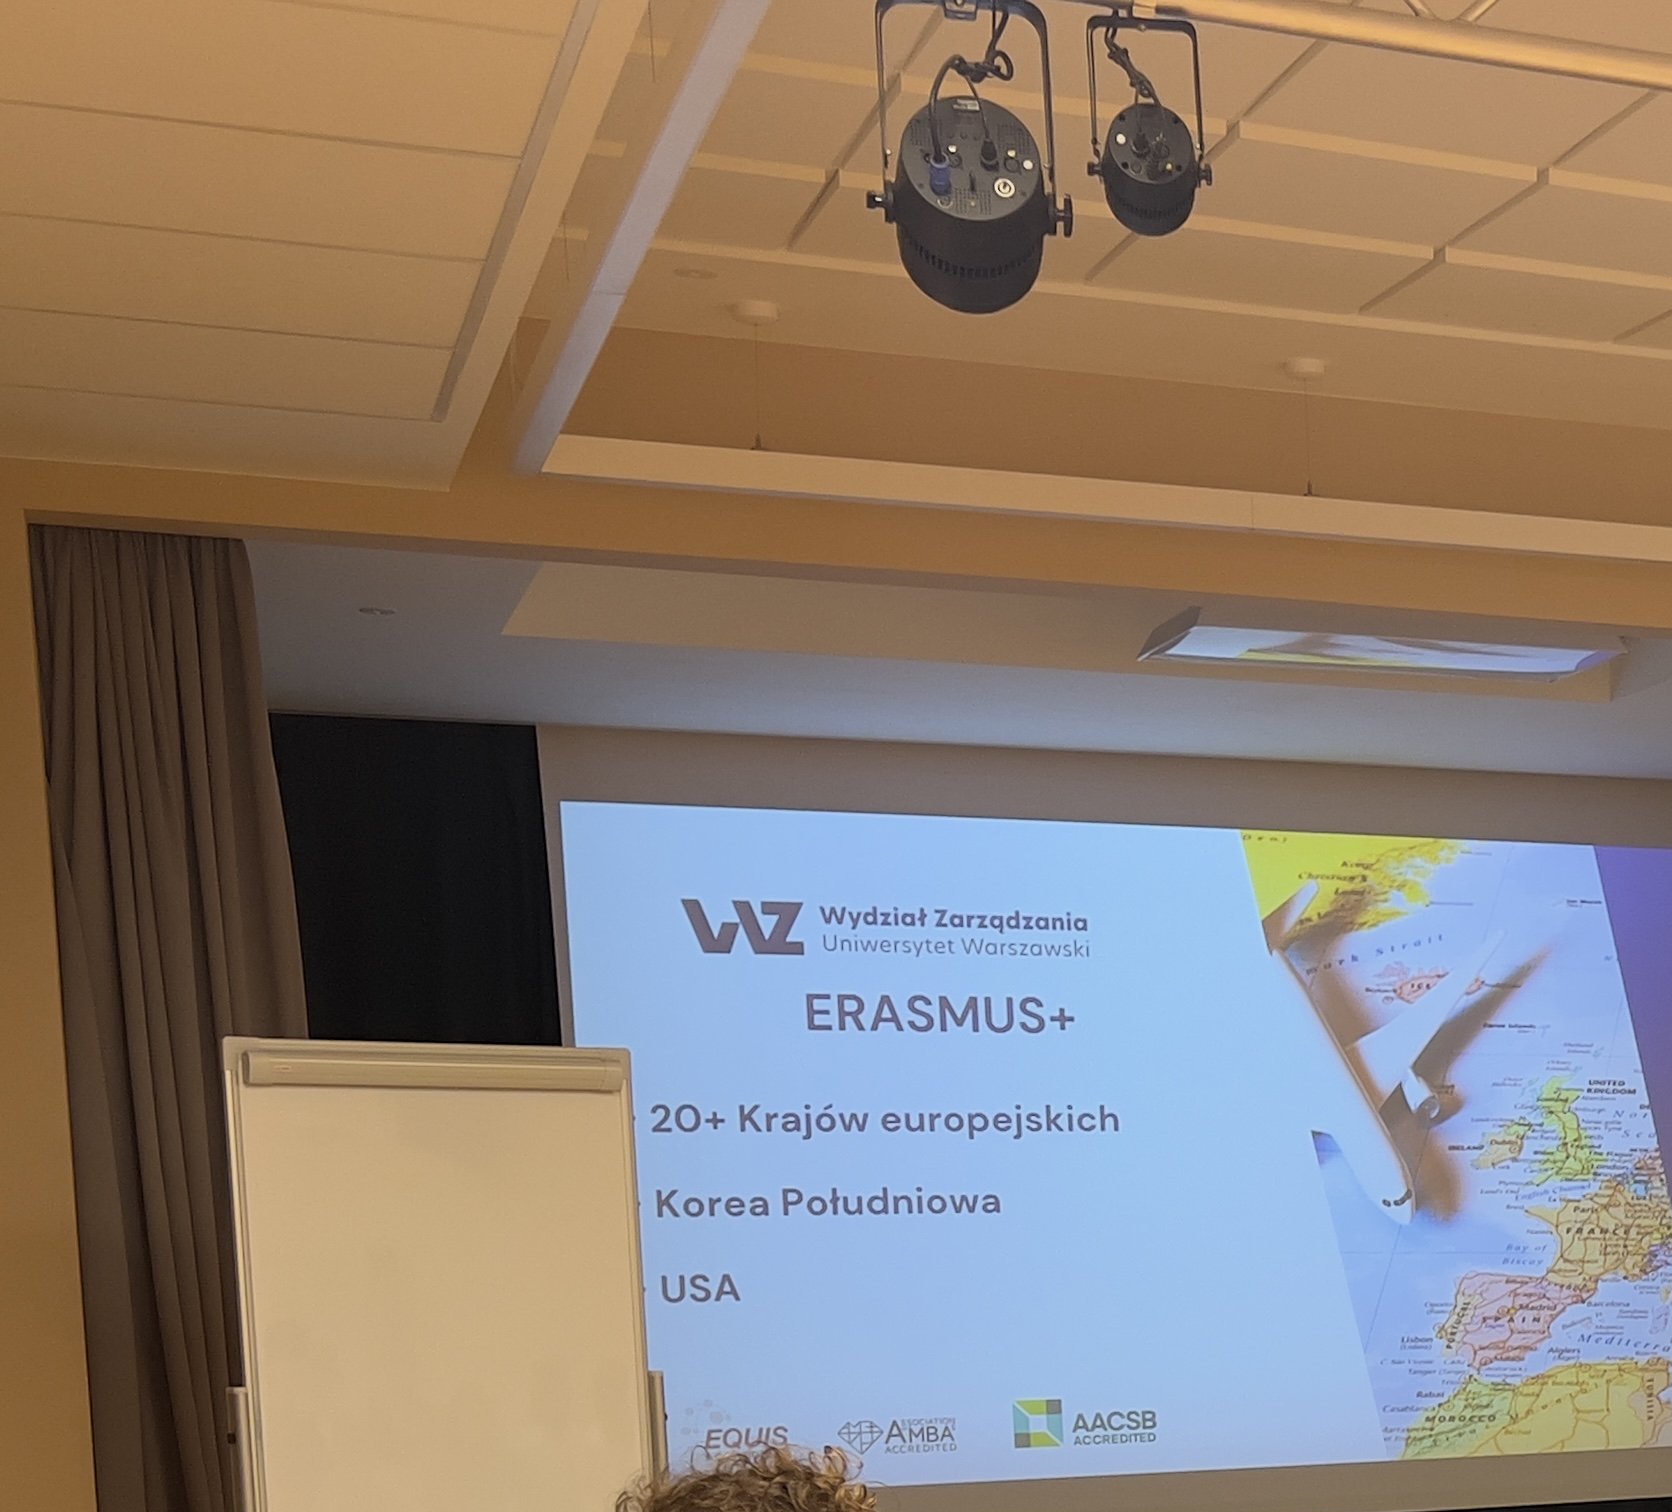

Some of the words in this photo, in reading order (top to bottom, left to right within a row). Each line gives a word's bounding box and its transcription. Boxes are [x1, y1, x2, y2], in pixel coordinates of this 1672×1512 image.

[681, 899, 804, 955] WZ
[820, 905, 927, 930] Wydział
[934, 909, 1089, 934] Zarządzania
[822, 934, 955, 957] Uniwersytet
[961, 937, 1090, 959] Warszawski
[805, 993, 1075, 1034] ERASMUS+
[651, 1104, 725, 1133] 20+
[738, 1103, 869, 1140] Krajów
[880, 1103, 1121, 1140] europejskich
[655, 1189, 770, 1218] Korea
[781, 1187, 1002, 1217] Południowa
[660, 1273, 741, 1303] USA
[1072, 1410, 1158, 1433] AACSB
[1425, 1414, 1496, 1424] MOROCCO
[705, 1426, 789, 1449] EQUIS
[884, 1443, 957, 1455] ACCREDITED
[1073, 1432, 1157, 1446] ACCREDITED
